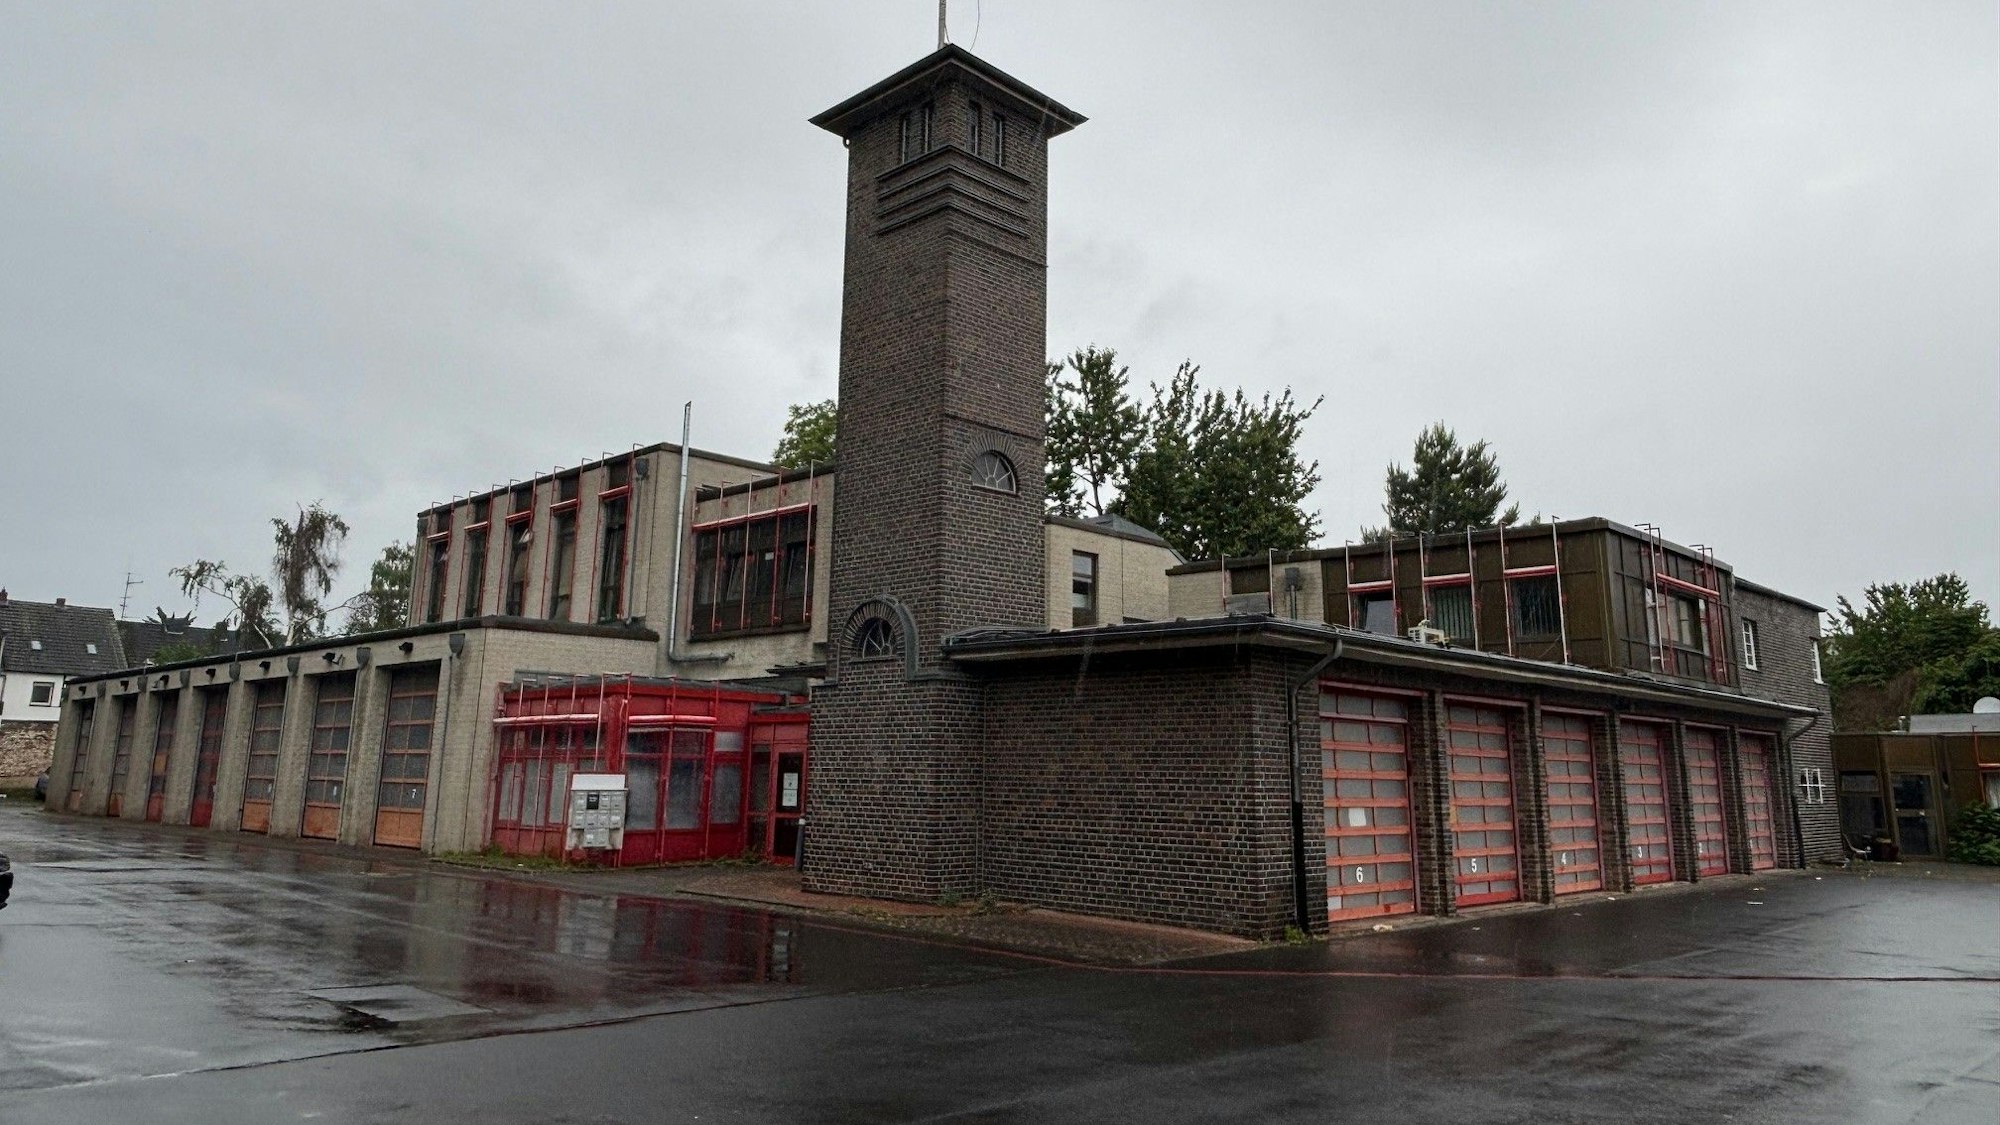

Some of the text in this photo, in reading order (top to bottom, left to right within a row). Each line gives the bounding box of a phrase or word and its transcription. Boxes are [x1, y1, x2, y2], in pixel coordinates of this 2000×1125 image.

[1561, 852, 1567, 865] 4
[1638, 846, 1643, 858] 3
[1471, 858, 1477, 873] 5
[1356, 866, 1363, 883] 6
